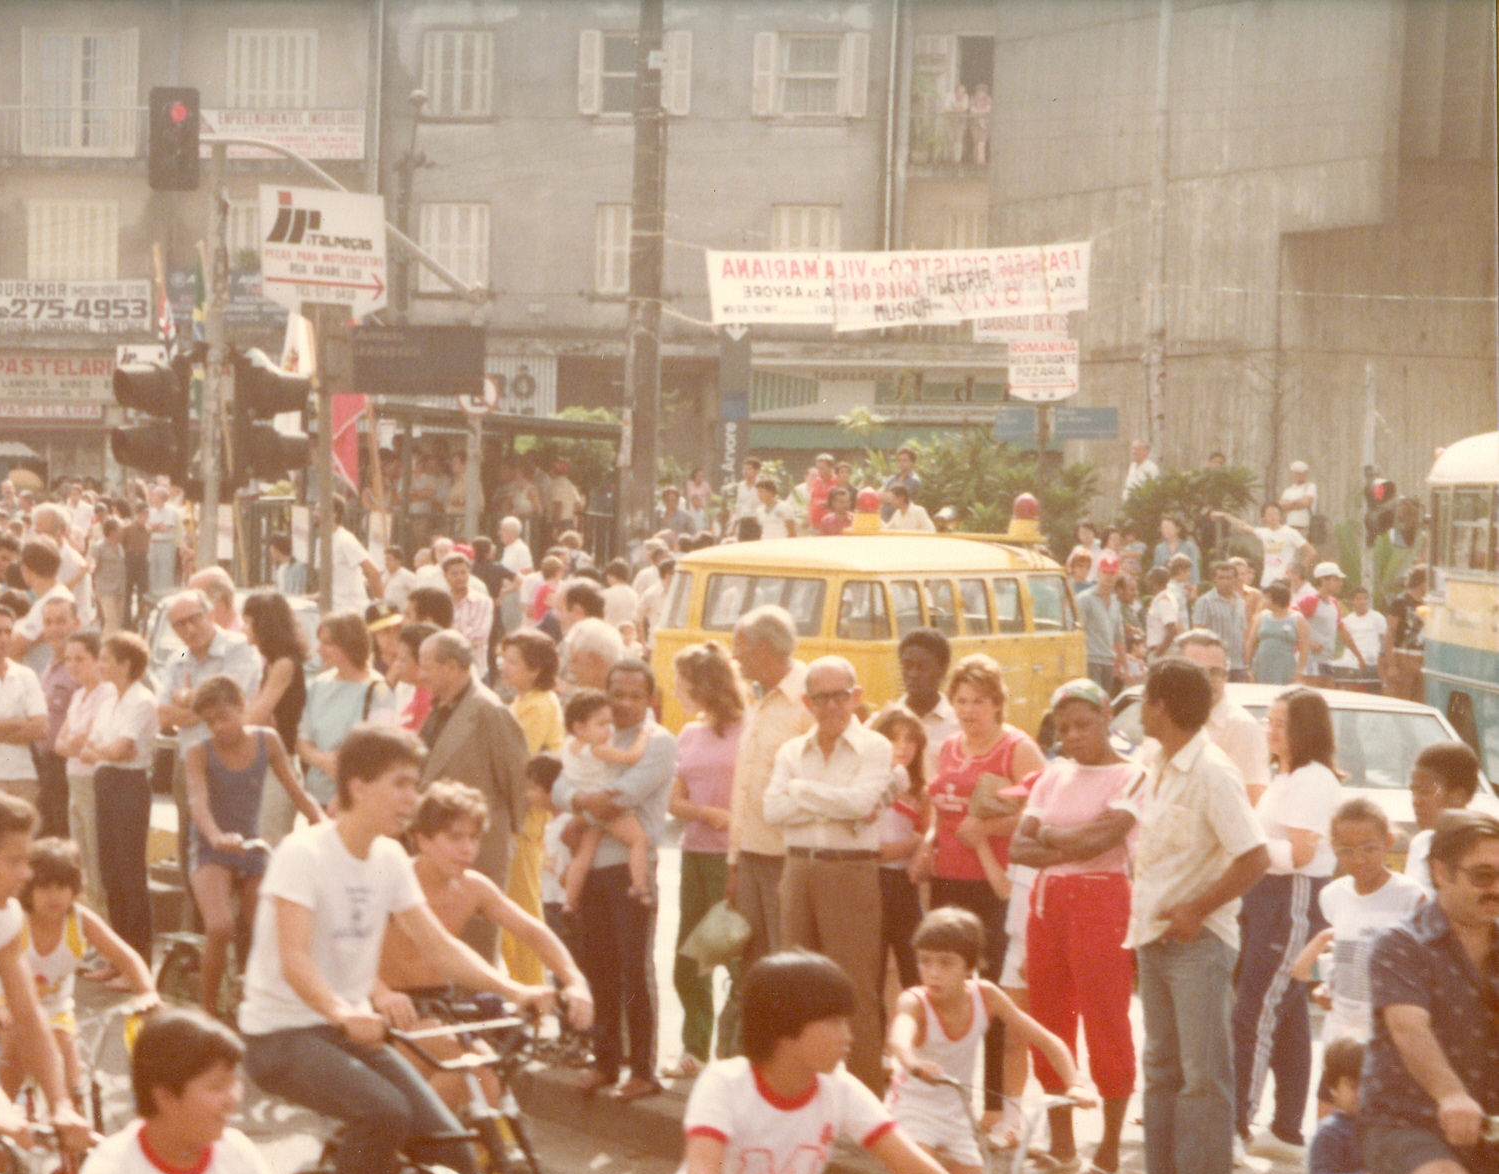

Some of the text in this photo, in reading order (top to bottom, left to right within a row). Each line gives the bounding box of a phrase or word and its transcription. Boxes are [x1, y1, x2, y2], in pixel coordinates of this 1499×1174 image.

[10, 299, 148, 320] 275-4953
[1011, 342, 1077, 352] ROMANINA
[1016, 366, 1066, 376] PIZZARIA
